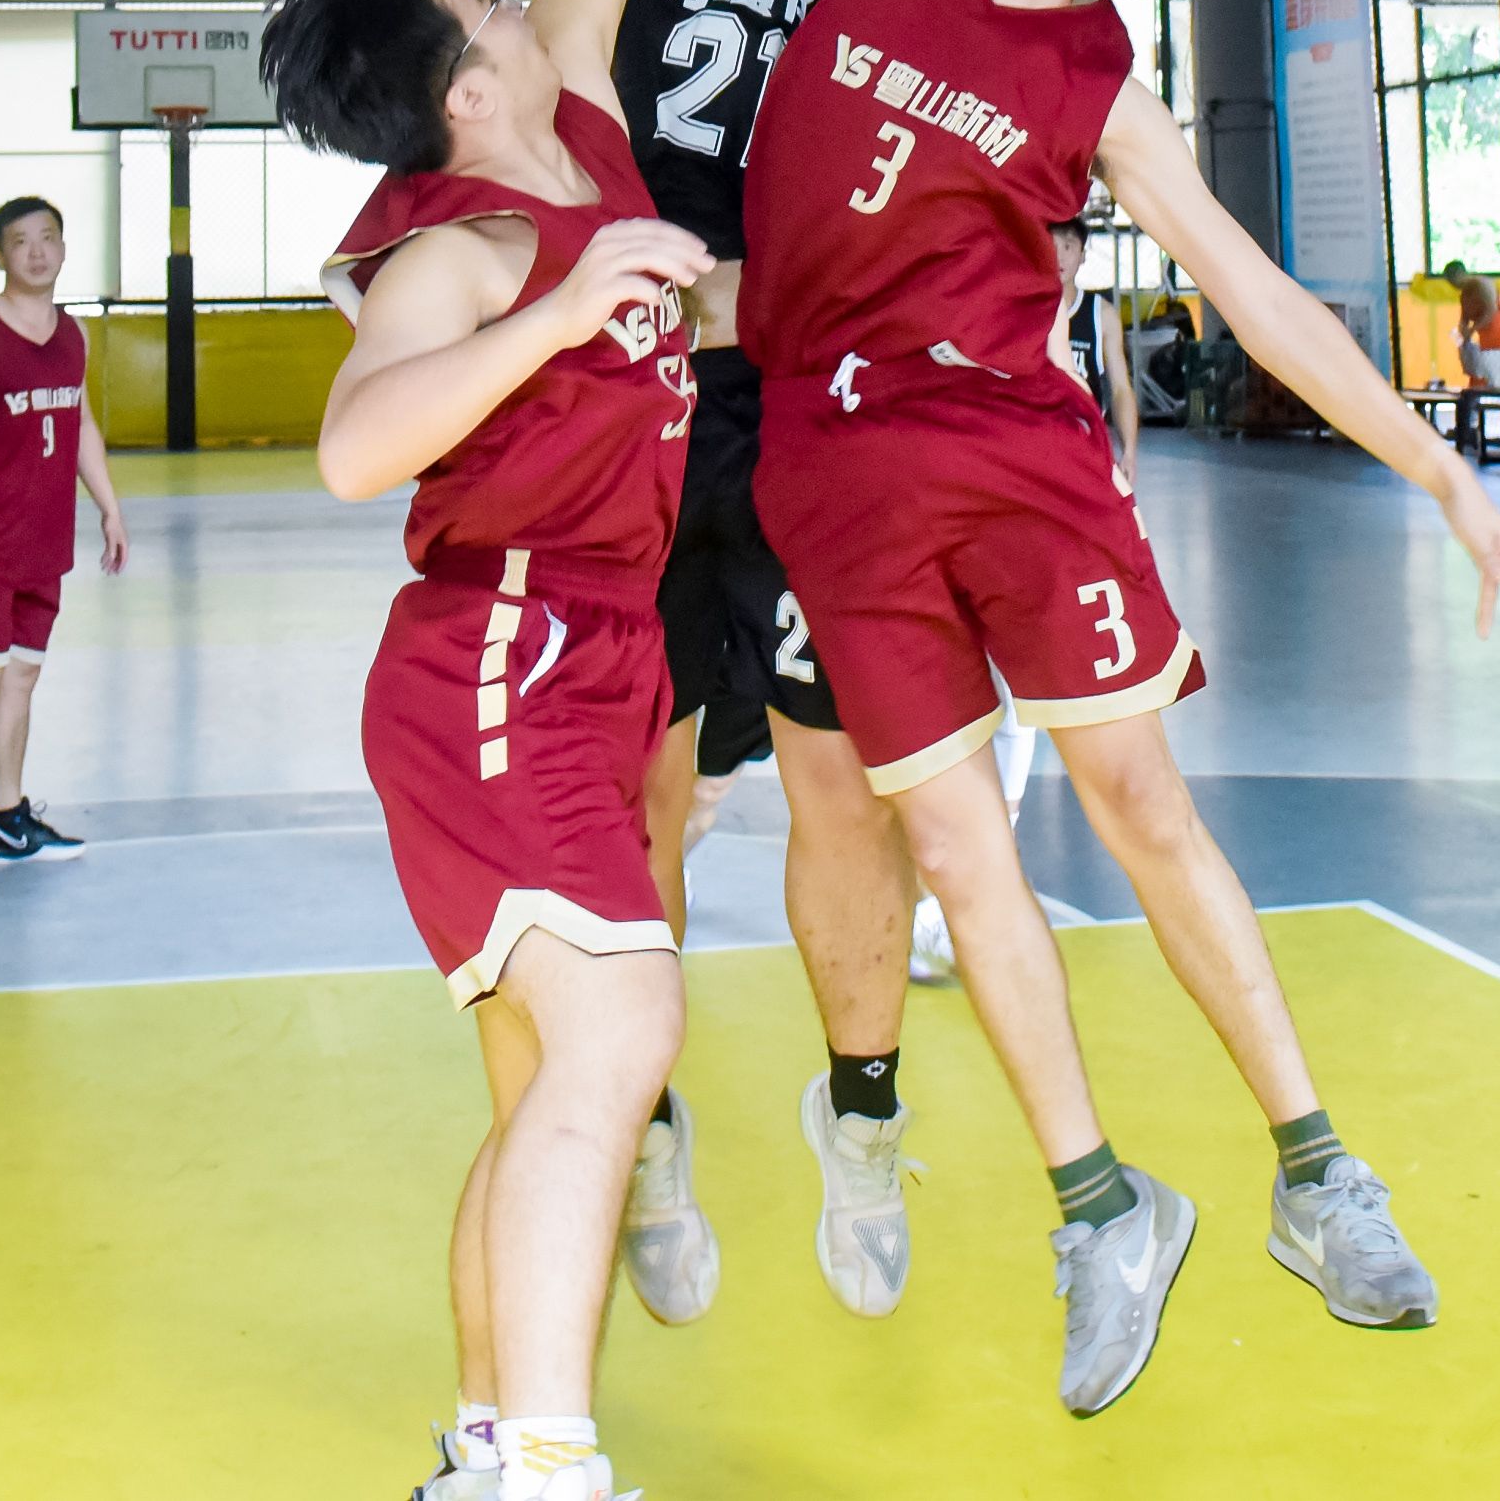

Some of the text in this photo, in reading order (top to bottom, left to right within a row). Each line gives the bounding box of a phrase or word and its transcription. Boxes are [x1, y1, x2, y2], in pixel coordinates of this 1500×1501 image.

[110, 29, 197, 50] TUTTI
[830, 33, 884, 89] YS
[848, 120, 915, 215] 3
[43, 414, 54, 458] 9
[776, 590, 815, 683] 2
[1077, 579, 1137, 680] 3
